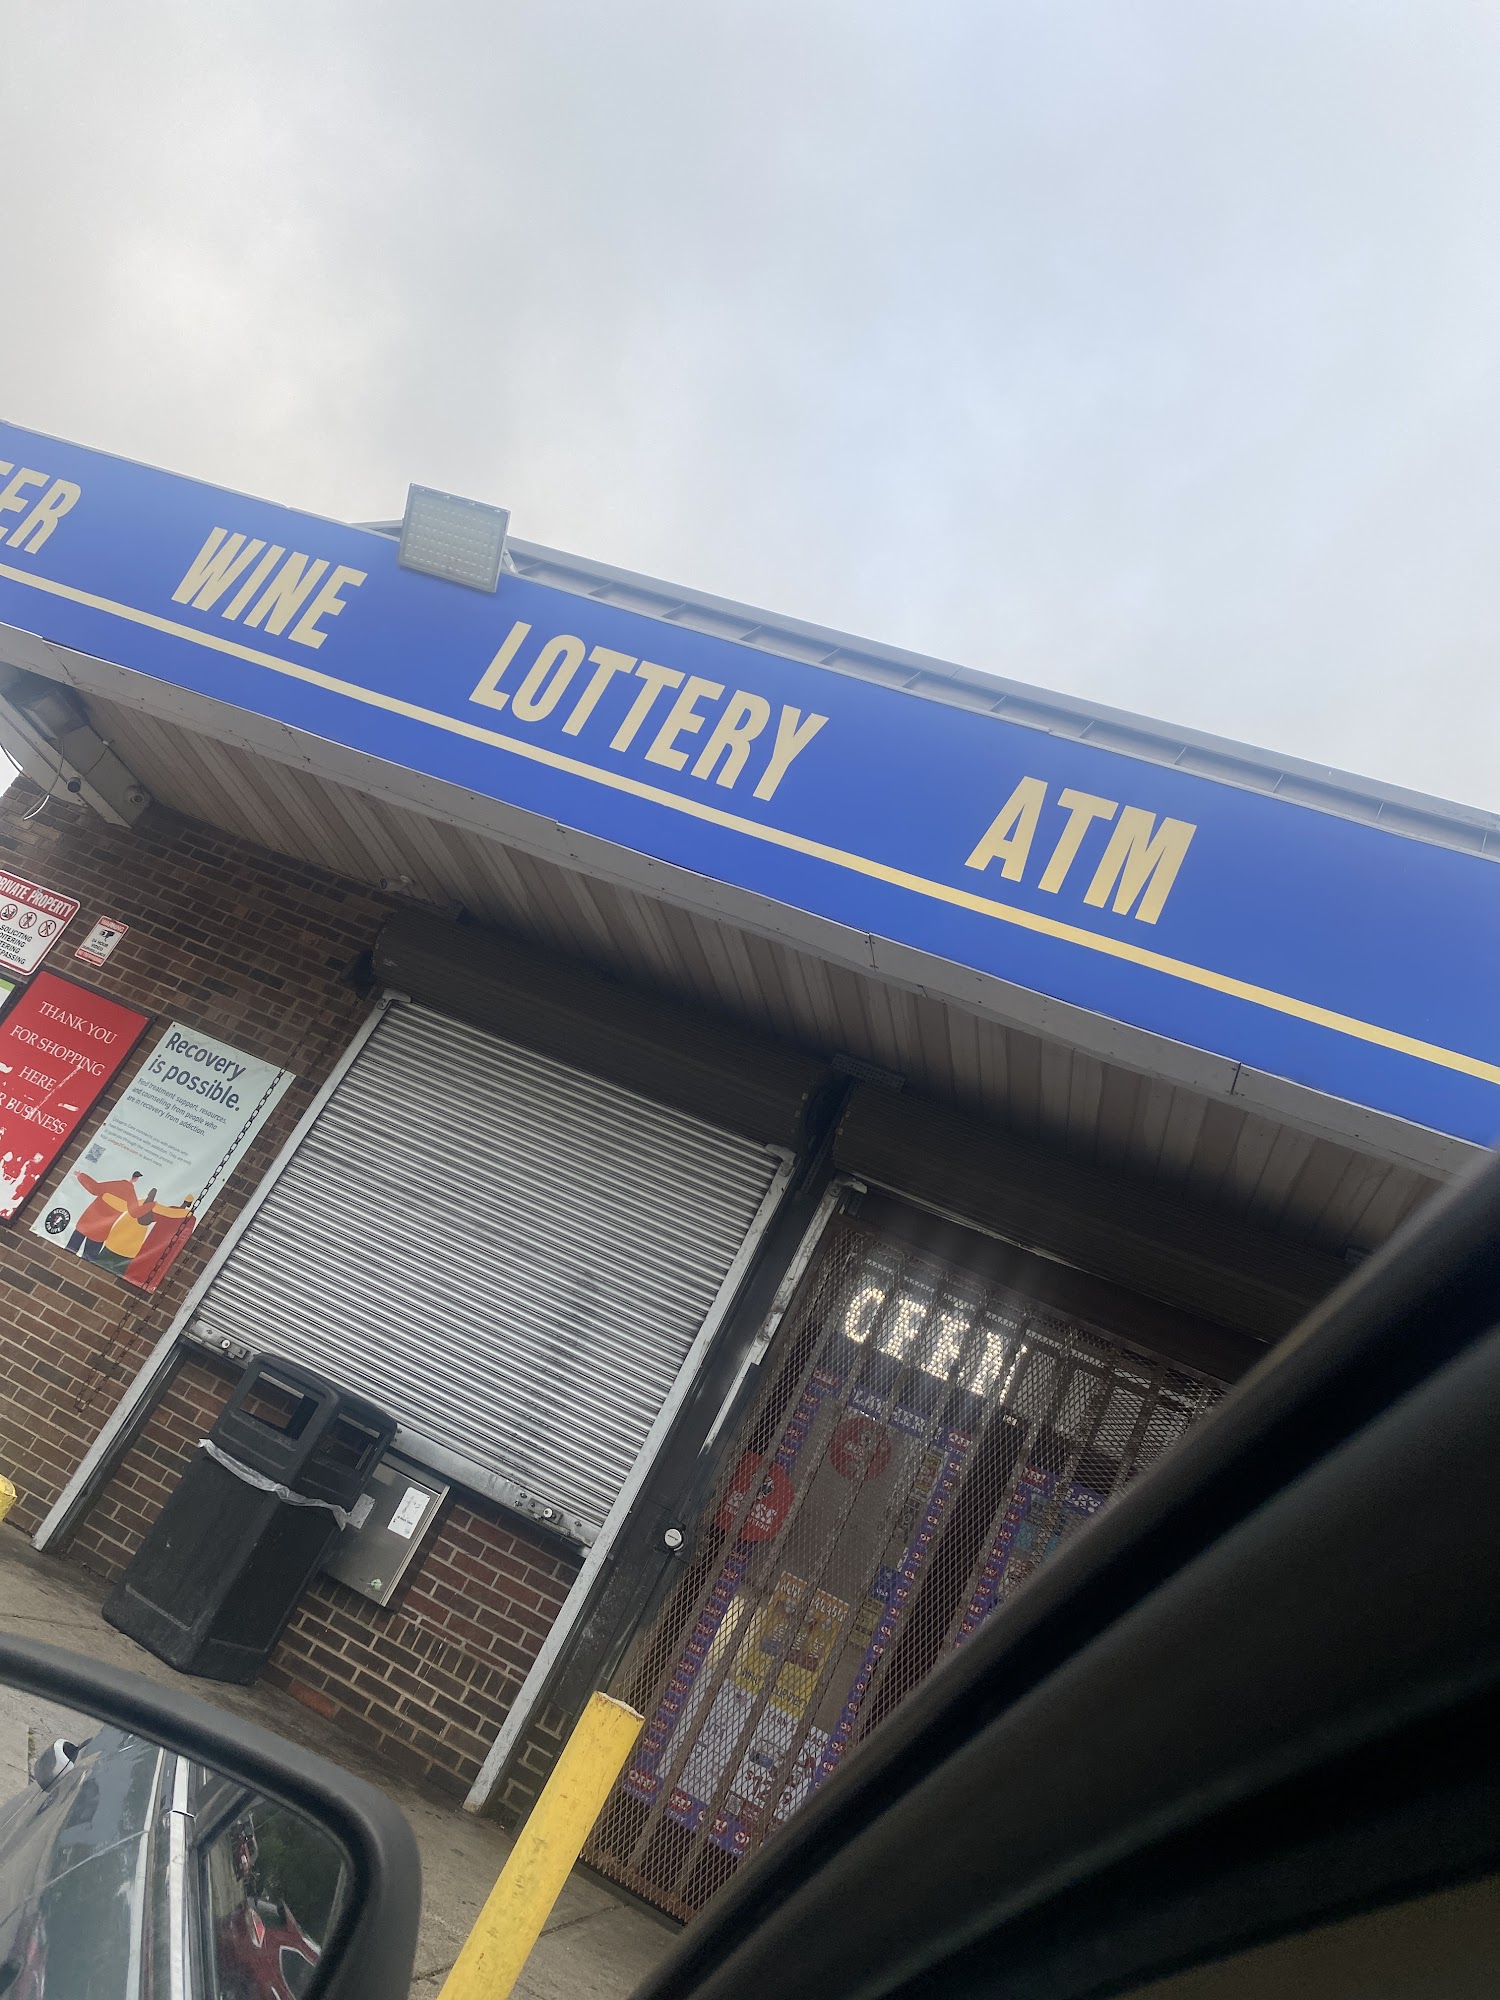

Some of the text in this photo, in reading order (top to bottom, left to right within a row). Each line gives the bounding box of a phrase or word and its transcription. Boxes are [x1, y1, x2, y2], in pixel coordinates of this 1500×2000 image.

[171, 527, 368, 649] WINE
[469, 620, 829, 801] LOTTERY
[964, 775, 1197, 925] ATM
[26, 889, 75, 918] PROPERTY
[38, 1001, 118, 1044] THANK YOU
[10, 1025, 105, 1077] FOR SHOPPING
[165, 1032, 246, 1082] Recovery
[18, 1066, 57, 1091] HERE
[138, 1078, 149, 1087] Find
[148, 1082, 176, 1100] treatment
[148, 1054, 240, 1112] is possible.
[5, 1097, 68, 1135] BUSINESS
[132, 1087, 218, 1130] and counseling from people who
[140, 1100, 165, 1117] recovery
[164, 1112, 180, 1123] from
